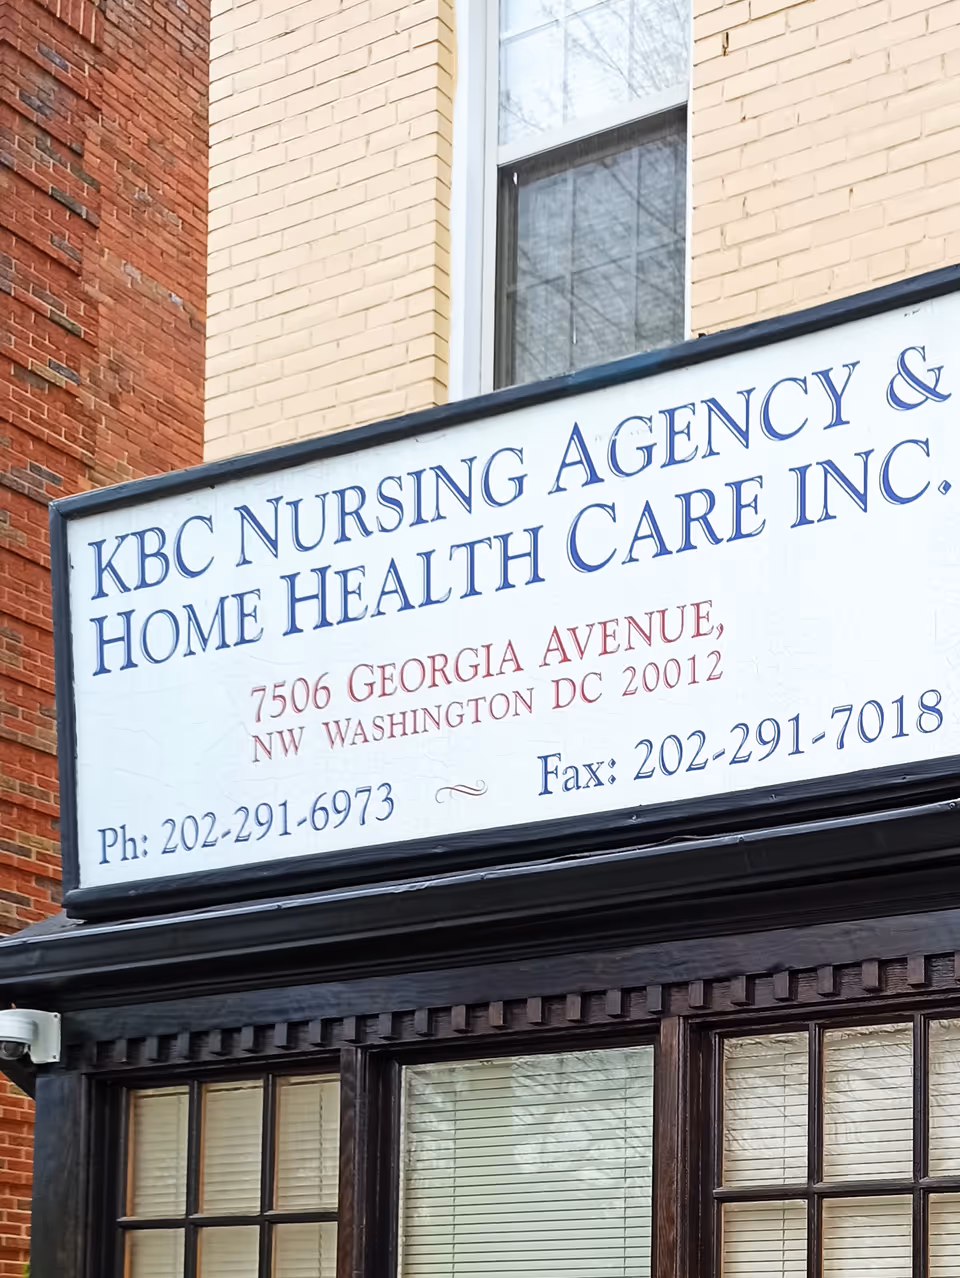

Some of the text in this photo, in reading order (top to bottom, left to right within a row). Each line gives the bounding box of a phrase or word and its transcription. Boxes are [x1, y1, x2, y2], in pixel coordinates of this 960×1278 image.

[88, 344, 953, 601] KBC NURSING AGENCY &
[89, 437, 953, 678] HOME HEALTH CARE INC.
[250, 599, 726, 724] 7506 GEORGIA AVENUE,
[250, 647, 724, 763] NW WASHINGTON DC 20012
[96, 688, 944, 866] Ph: 202-291-6973 Fax: 202-291-7018
